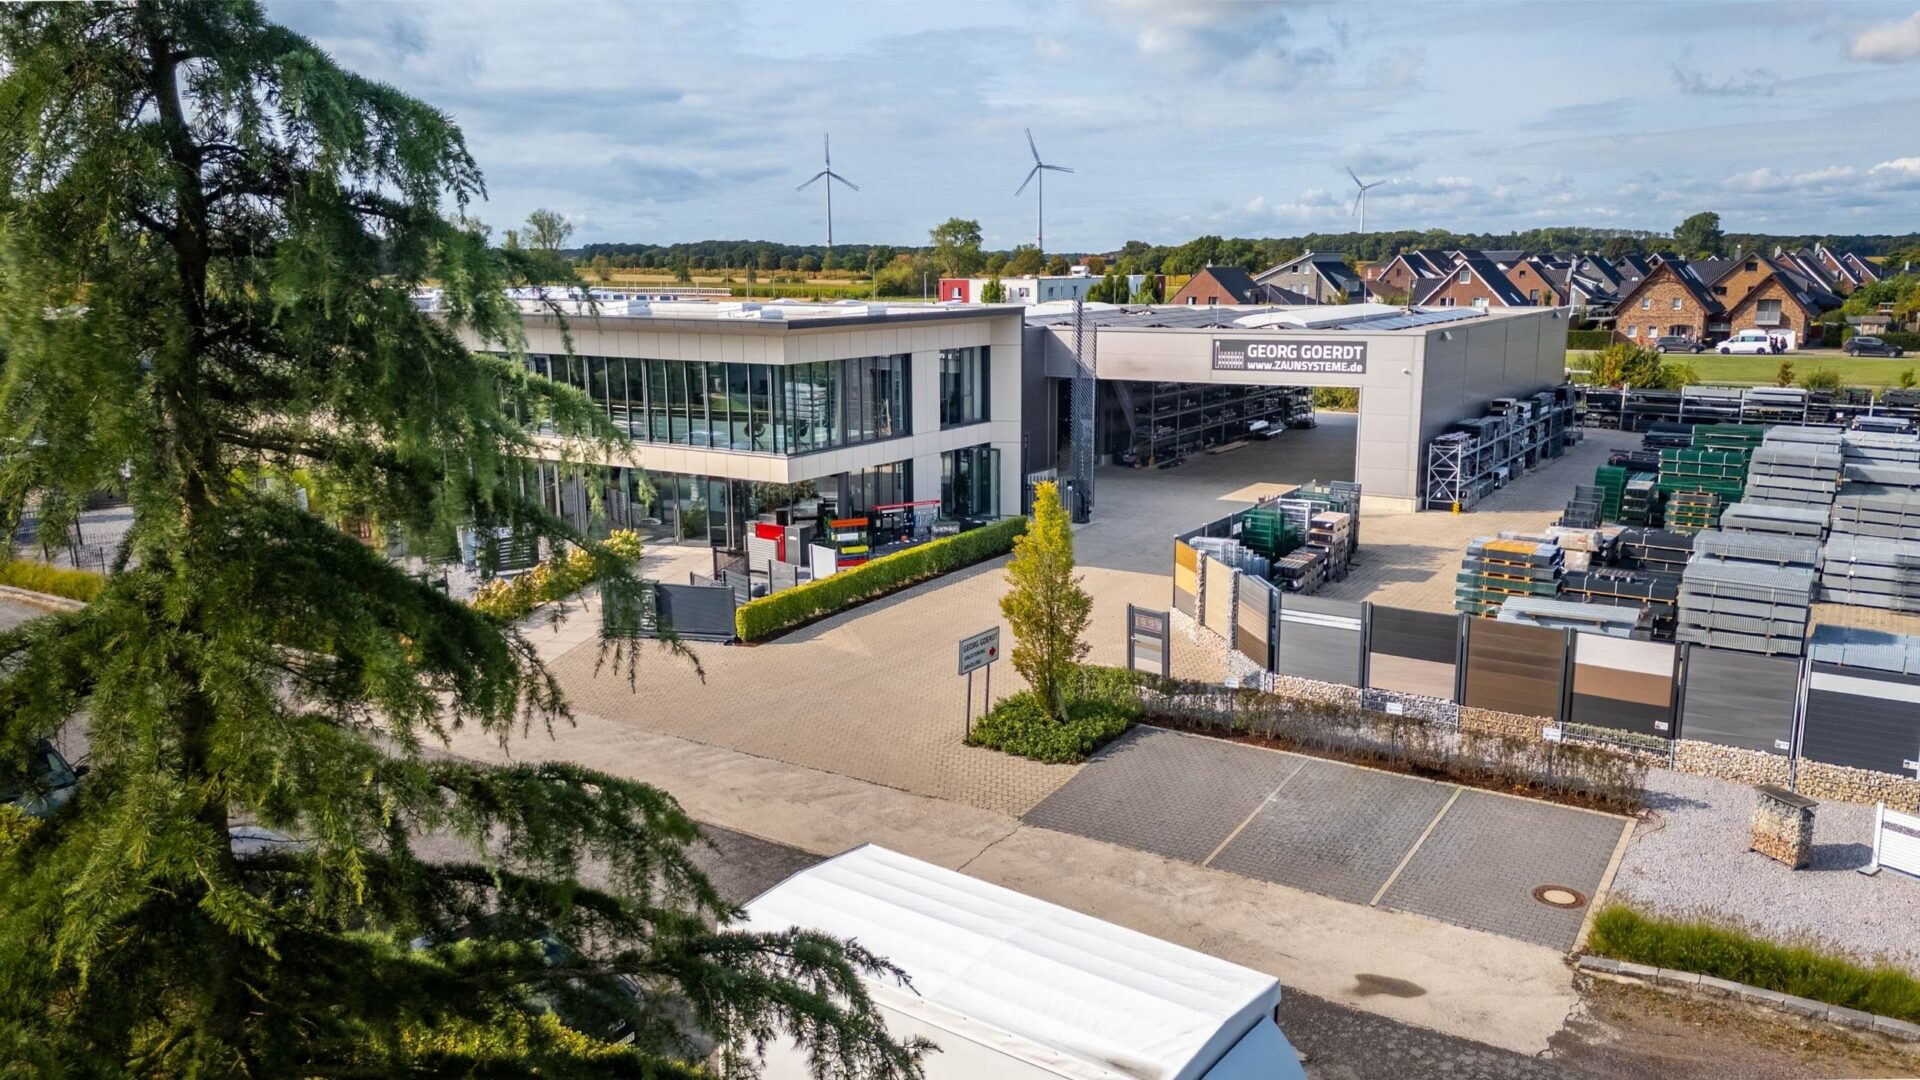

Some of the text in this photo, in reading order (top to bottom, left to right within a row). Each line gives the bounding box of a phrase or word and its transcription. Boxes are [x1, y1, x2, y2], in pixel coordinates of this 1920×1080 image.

[1247, 344, 1364, 360] GEORG GOERDT
[1247, 360, 1363, 372] www.ZAUNSYSTEME.de
